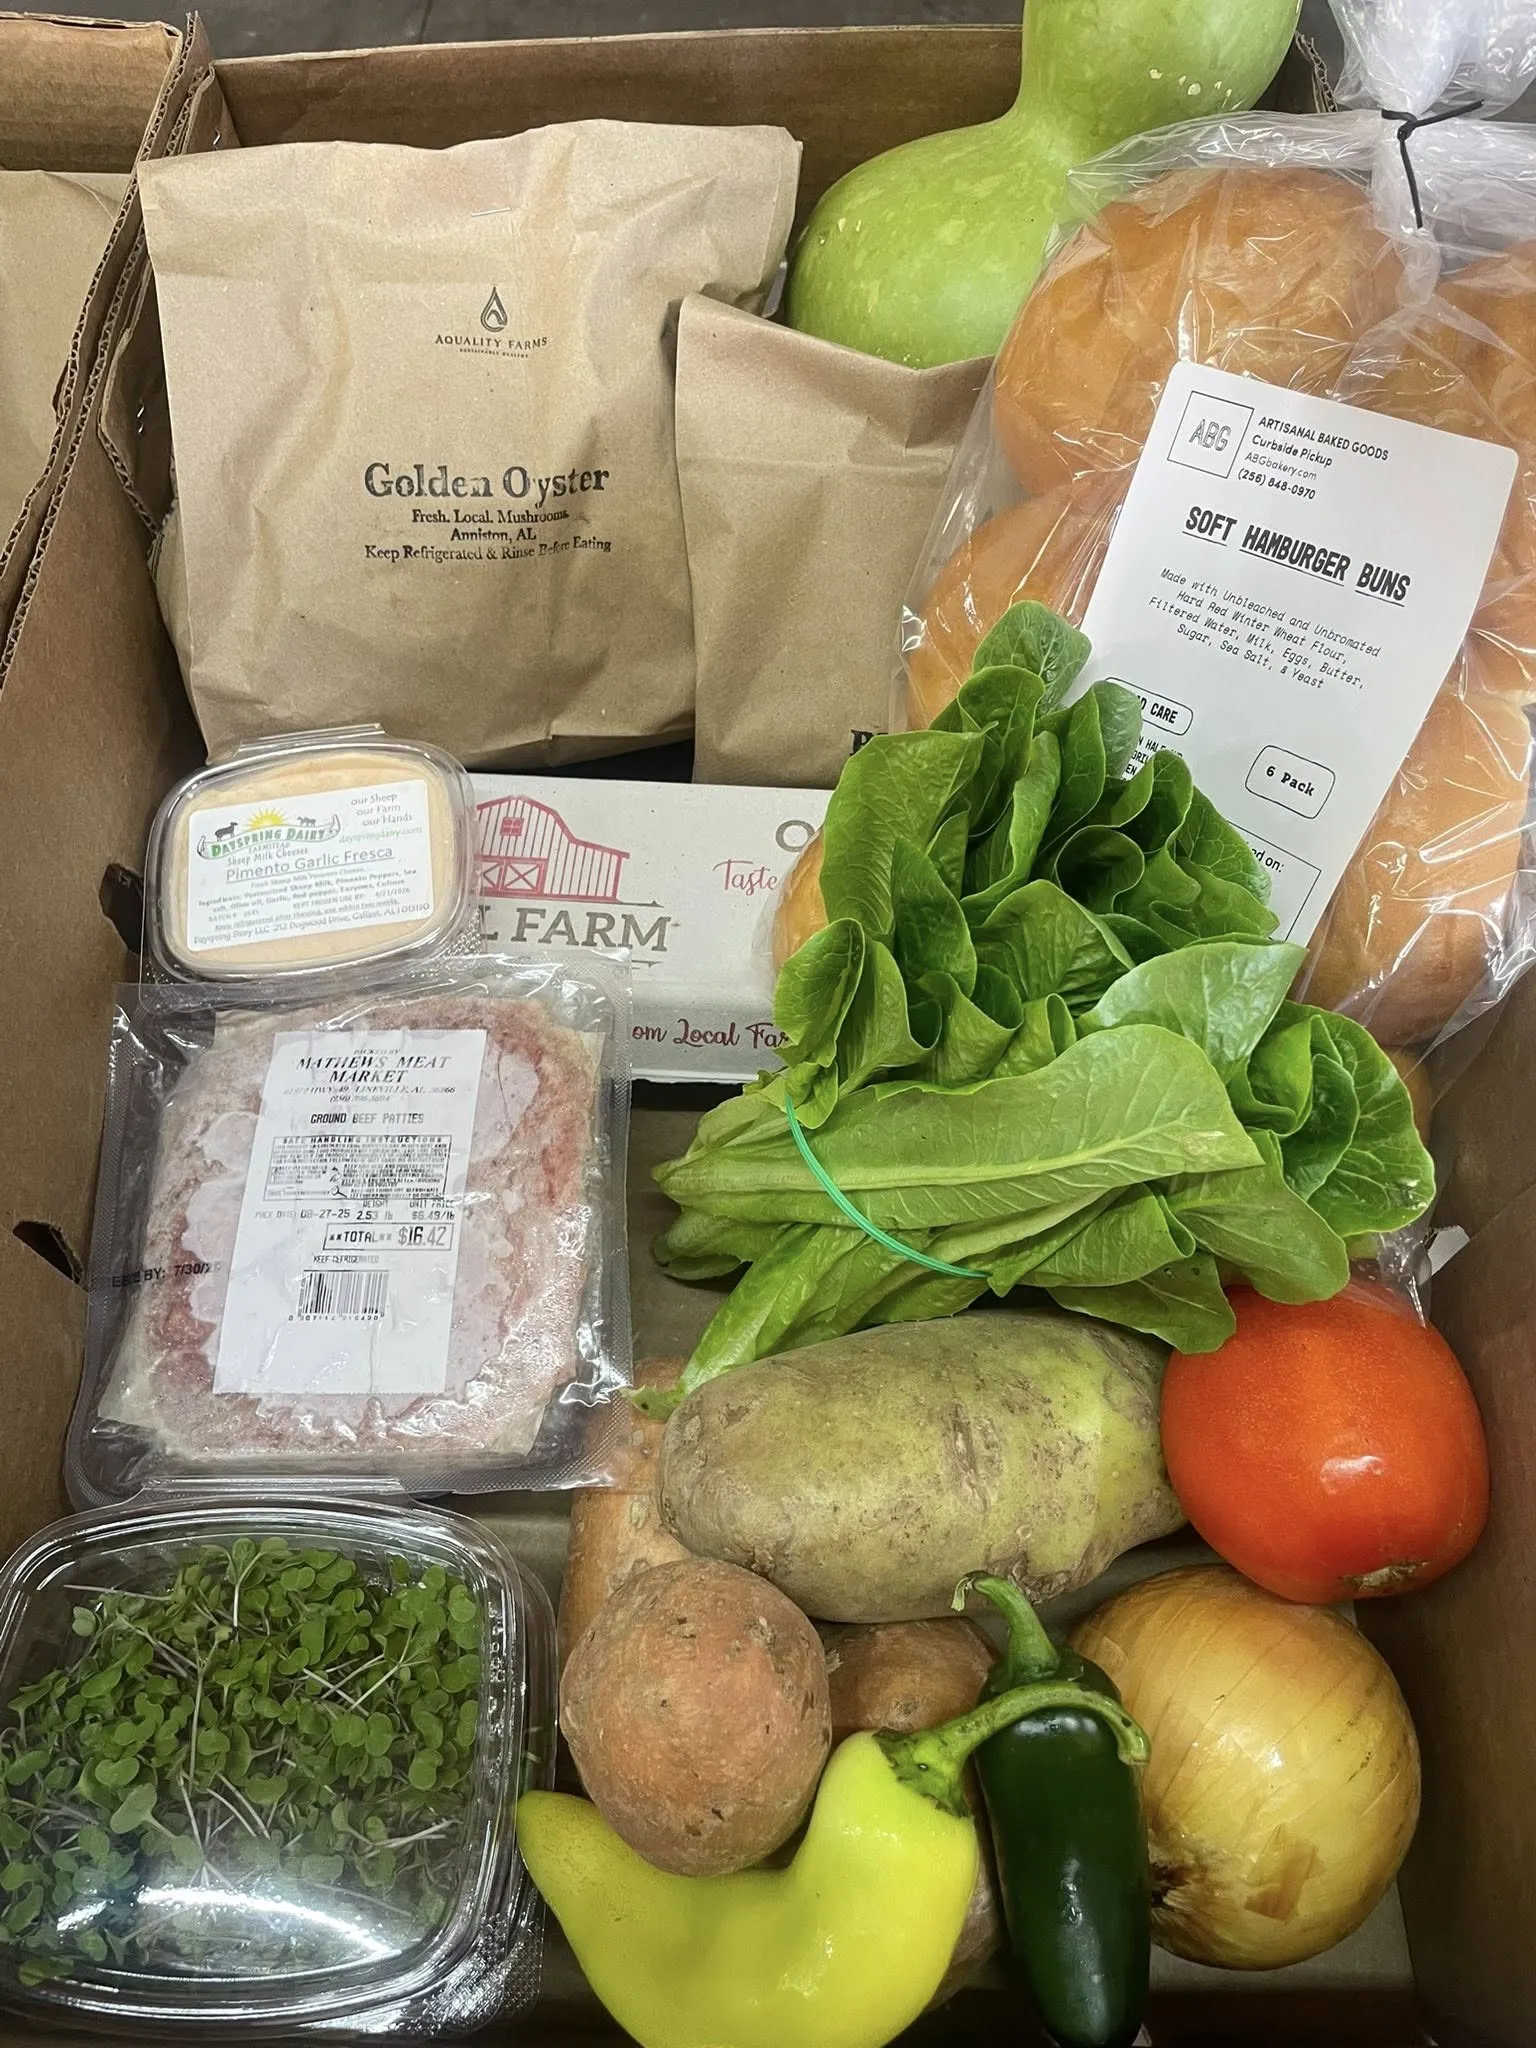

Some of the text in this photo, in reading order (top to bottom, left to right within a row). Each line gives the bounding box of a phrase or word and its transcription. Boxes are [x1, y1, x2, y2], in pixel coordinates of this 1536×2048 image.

[435, 334, 548, 350] AQUALITY FARMS
[1189, 418, 1232, 452] ABG
[1258, 416, 1389, 462] ARTISANAL BAKED GOODS
[1251, 434, 1333, 468] Curbside Pickup
[1244, 451, 1318, 481] ABGbakery.com
[364, 462, 610, 509] Golden Oyster
[1237, 467, 1316, 500] (256) 848-0970
[412, 509, 450, 524] Fresh.
[453, 509, 494, 524] Local.
[450, 527, 537, 544] Anniston, AL
[364, 545, 400, 562] Keep
[402, 545, 483, 563] Refrigerated
[486, 547, 498, 560] &
[501, 546, 535, 560] Rinse
[572, 535, 611, 552] Eating
[1185, 506, 1411, 602] SOFT HAMBURGER BUNS
[1160, 568, 1381, 657] Made with Unbleached and Unbromated
[1177, 590, 1346, 665] Hard Red Winter Wheat Flour,
[1148, 596, 1363, 690] Filtered Water, Milk, Eggs, Butter,
[1177, 623, 1212, 647] Sugar,
[1219, 640, 1240, 656] Sea
[1243, 649, 1272, 671] Salt,
[1291, 667, 1324, 688] Yeast
[1150, 702, 1179, 724] CARE
[1266, 765, 1315, 797] 6 Pack
[356, 804, 401, 816] our Farm
[370, 793, 398, 804] Sheep
[382, 812, 413, 824] Hands
[211, 826, 327, 857] DAYSPRING DAIRY
[226, 847, 393, 881] Pimento Garlic Fresca
[227, 847, 309, 866] Sheep Milk Cheeses
[1265, 857, 1284, 873] on:
[713, 859, 778, 896] Taste
[510, 907, 672, 952] FARM
[631, 1018, 790, 1049] om Local Far
[296, 1055, 452, 1070] MATHEWS MEAT
[328, 1069, 409, 1084] MARKET
[310, 1112, 425, 1125] GROUND BEEF PATTIES
[310, 1136, 361, 1144] HANDLING
[300, 1208, 351, 1220] 08-27-25
[356, 1209, 455, 1221] 2.53 lb $6.49/lb
[362, 1199, 389, 1209] WEIGHT
[409, 1199, 427, 1209] UNIT
[397, 1225, 448, 1247] $16.42
[143, 1266, 166, 1281] BY:
